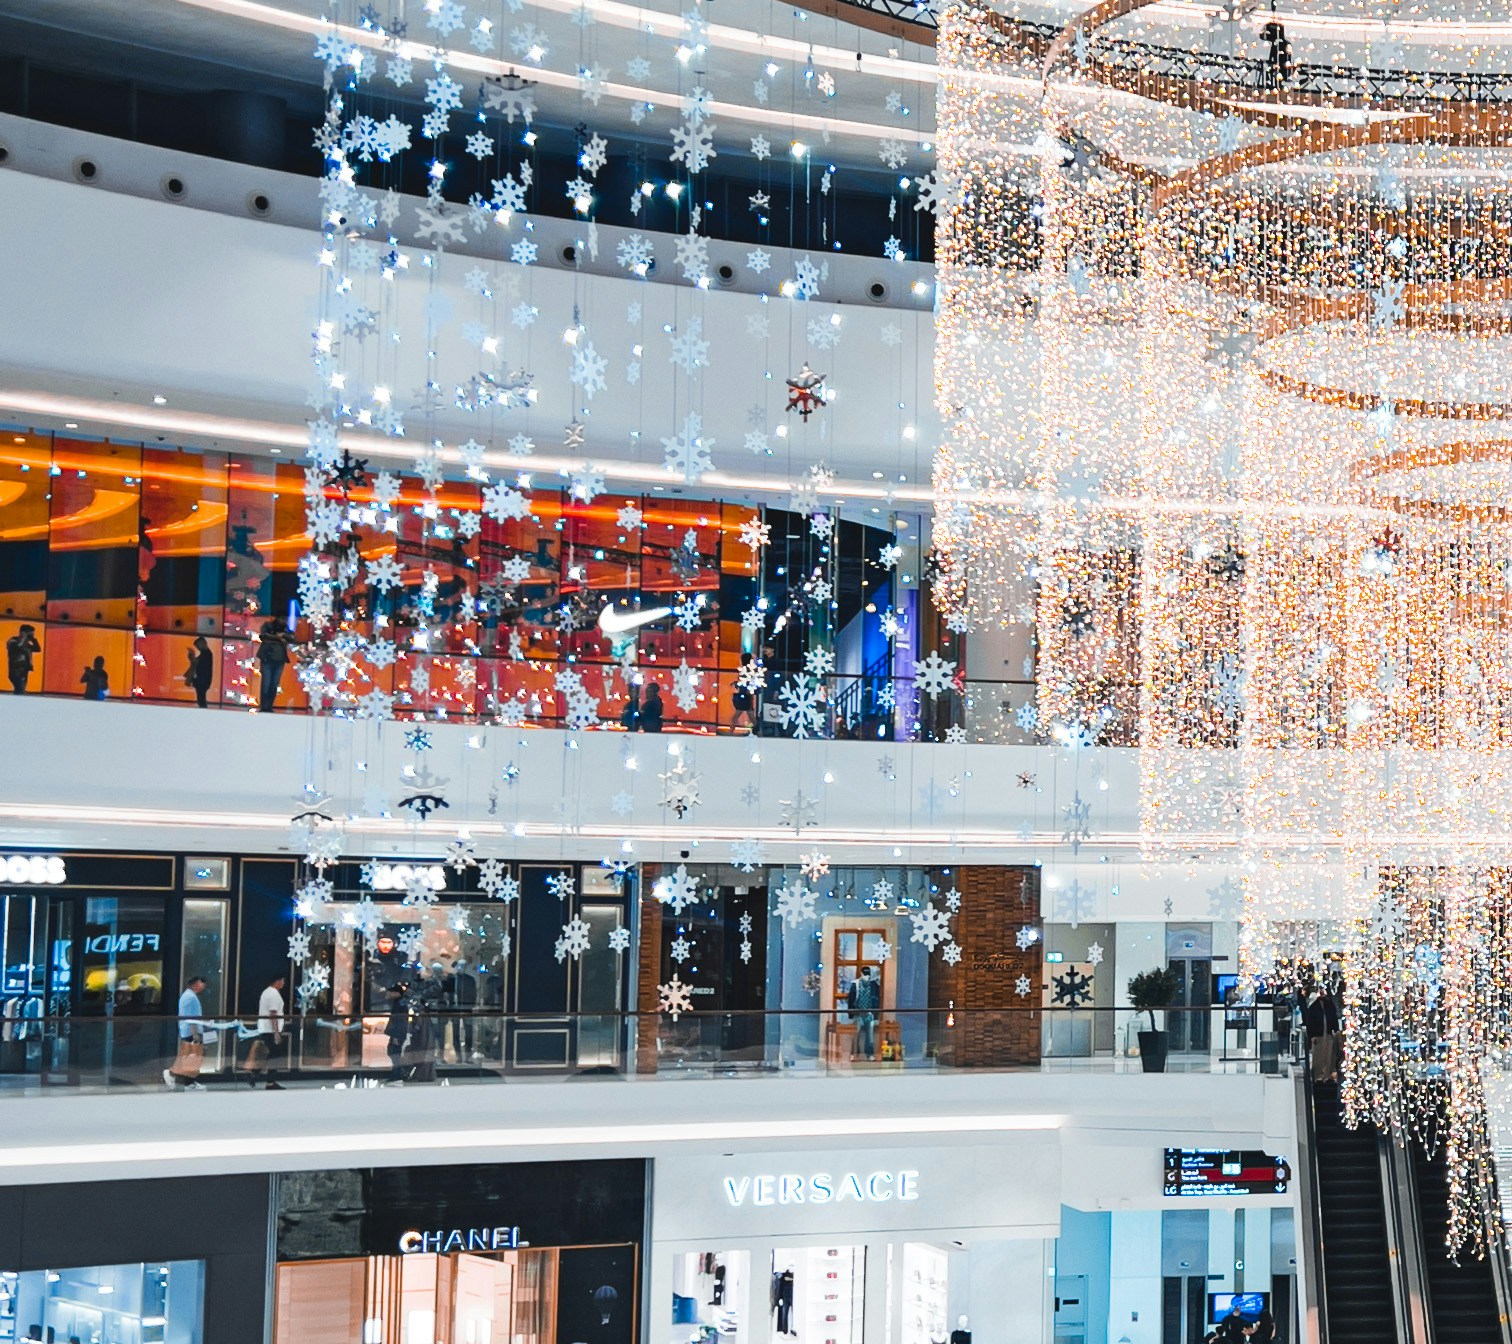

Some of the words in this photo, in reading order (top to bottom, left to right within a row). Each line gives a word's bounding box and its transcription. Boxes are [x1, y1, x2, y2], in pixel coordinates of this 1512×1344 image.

[723, 1170, 920, 1207] VERSACE
[399, 1226, 530, 1254] CHANEL
[1235, 1259, 1244, 1270] G
